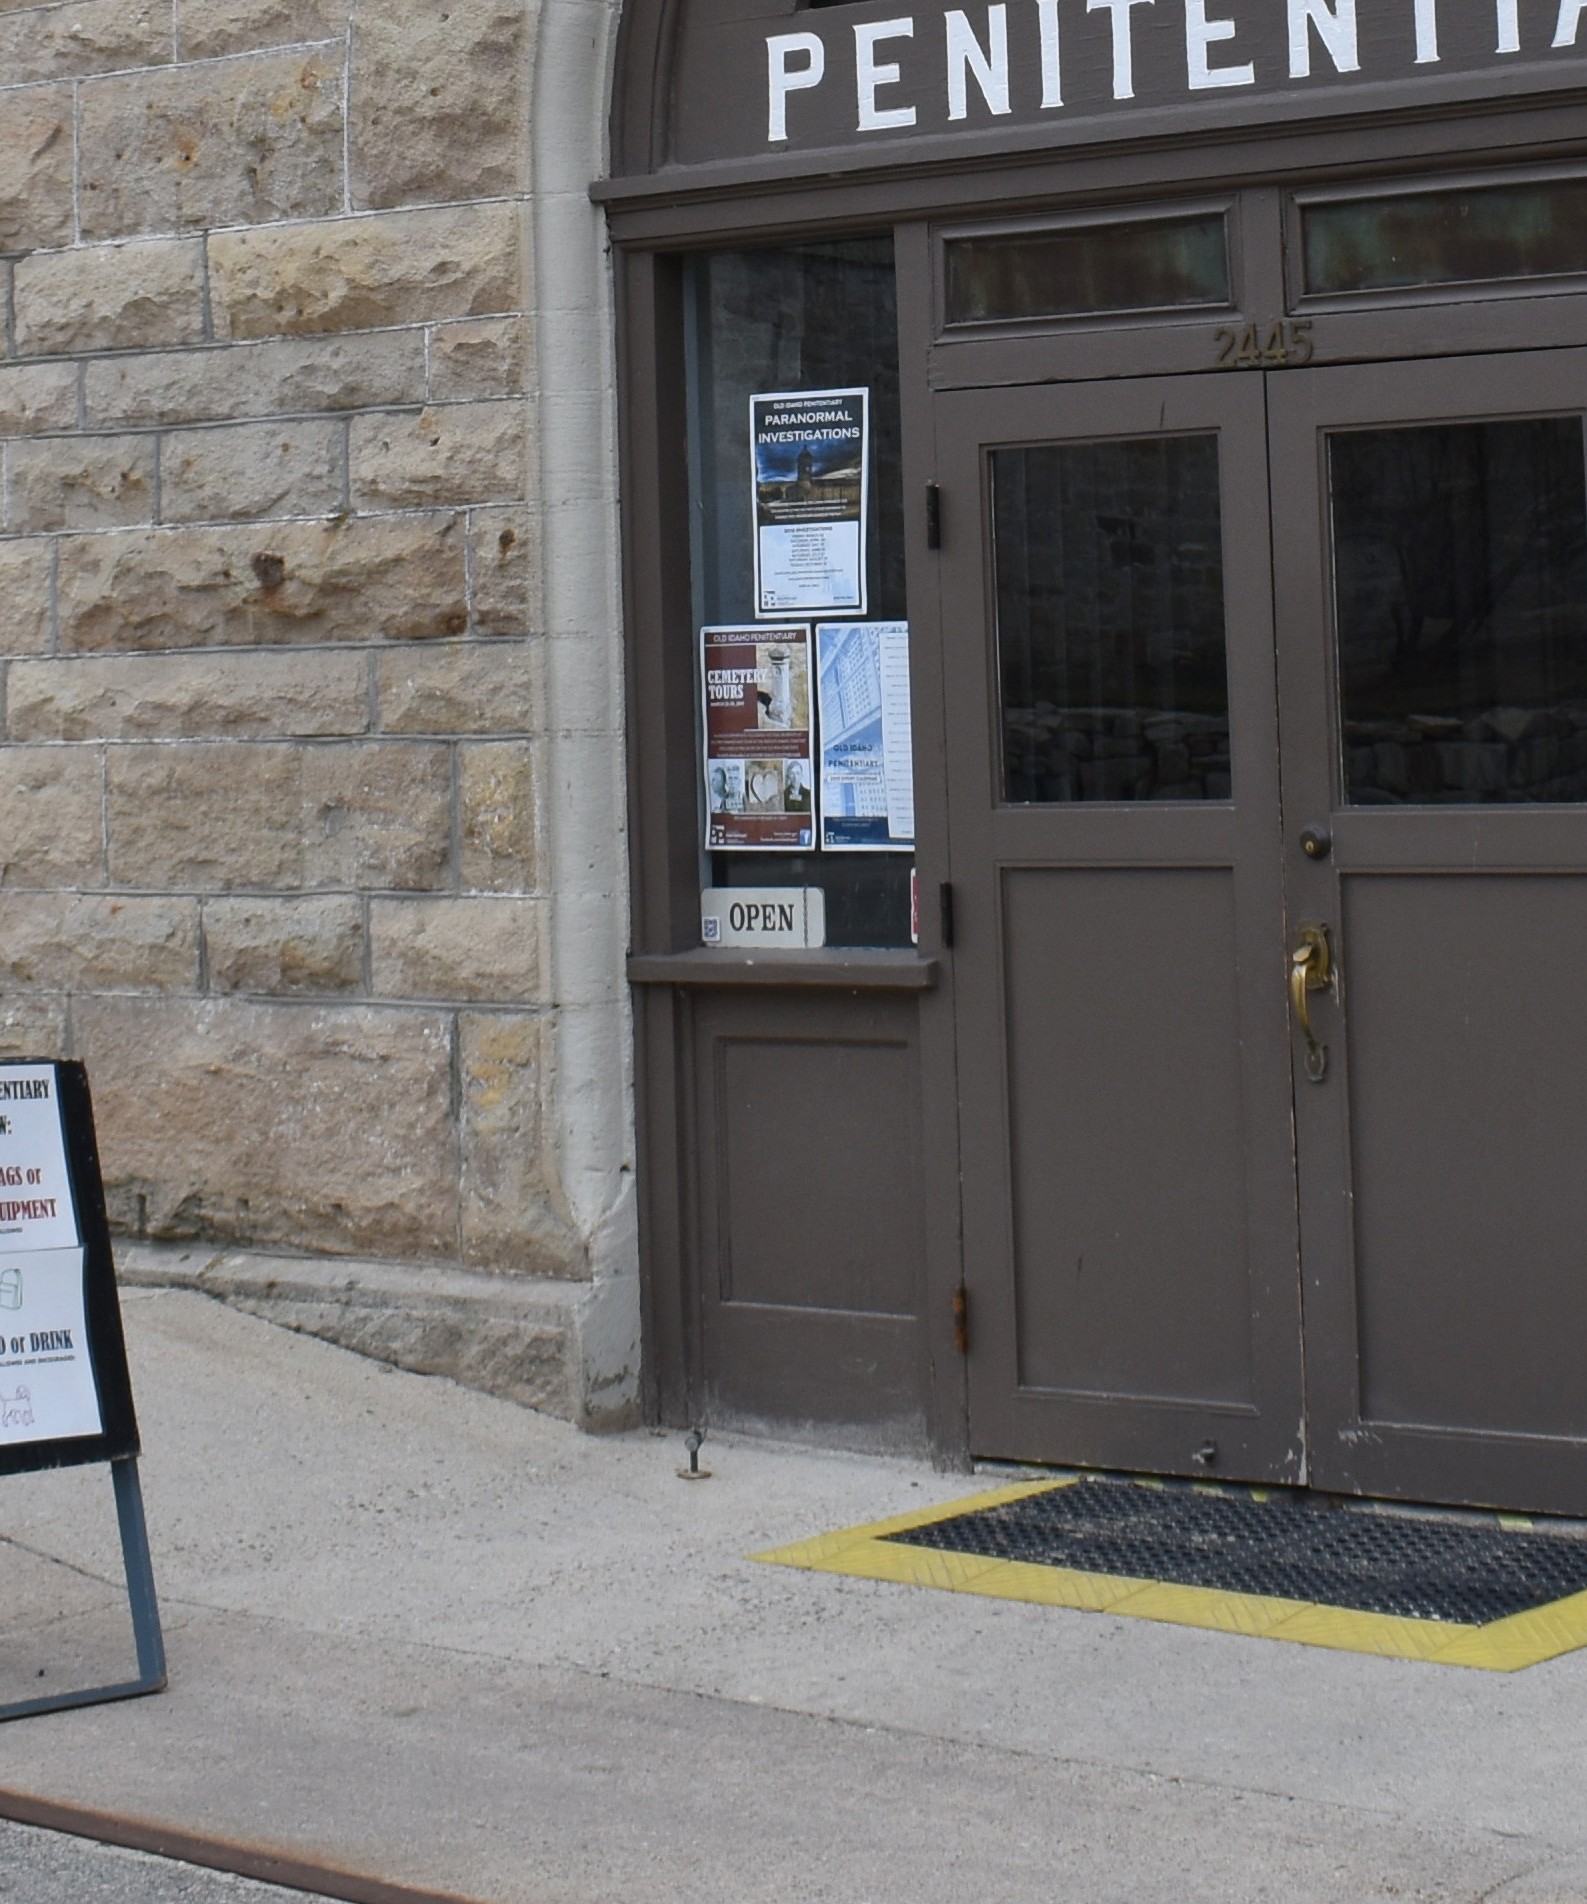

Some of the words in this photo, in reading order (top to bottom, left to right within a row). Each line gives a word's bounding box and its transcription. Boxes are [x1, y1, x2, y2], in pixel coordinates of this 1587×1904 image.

[1215, 321, 1313, 367] 2445
[765, 411, 852, 425] PARANORMAL
[758, 427, 860, 443] INVESTIGATIONS
[713, 634, 727, 642] OLD
[728, 633, 750, 641] IDAHO
[751, 632, 797, 640] PENITENTIARY
[708, 669, 767, 683] CEMETERY
[708, 685, 744, 699] TOURS
[730, 903, 794, 932] OPEN
[27, 1168, 41, 1185] or
[11, 1337, 25, 1353] or
[30, 1329, 73, 1351] DRINK
